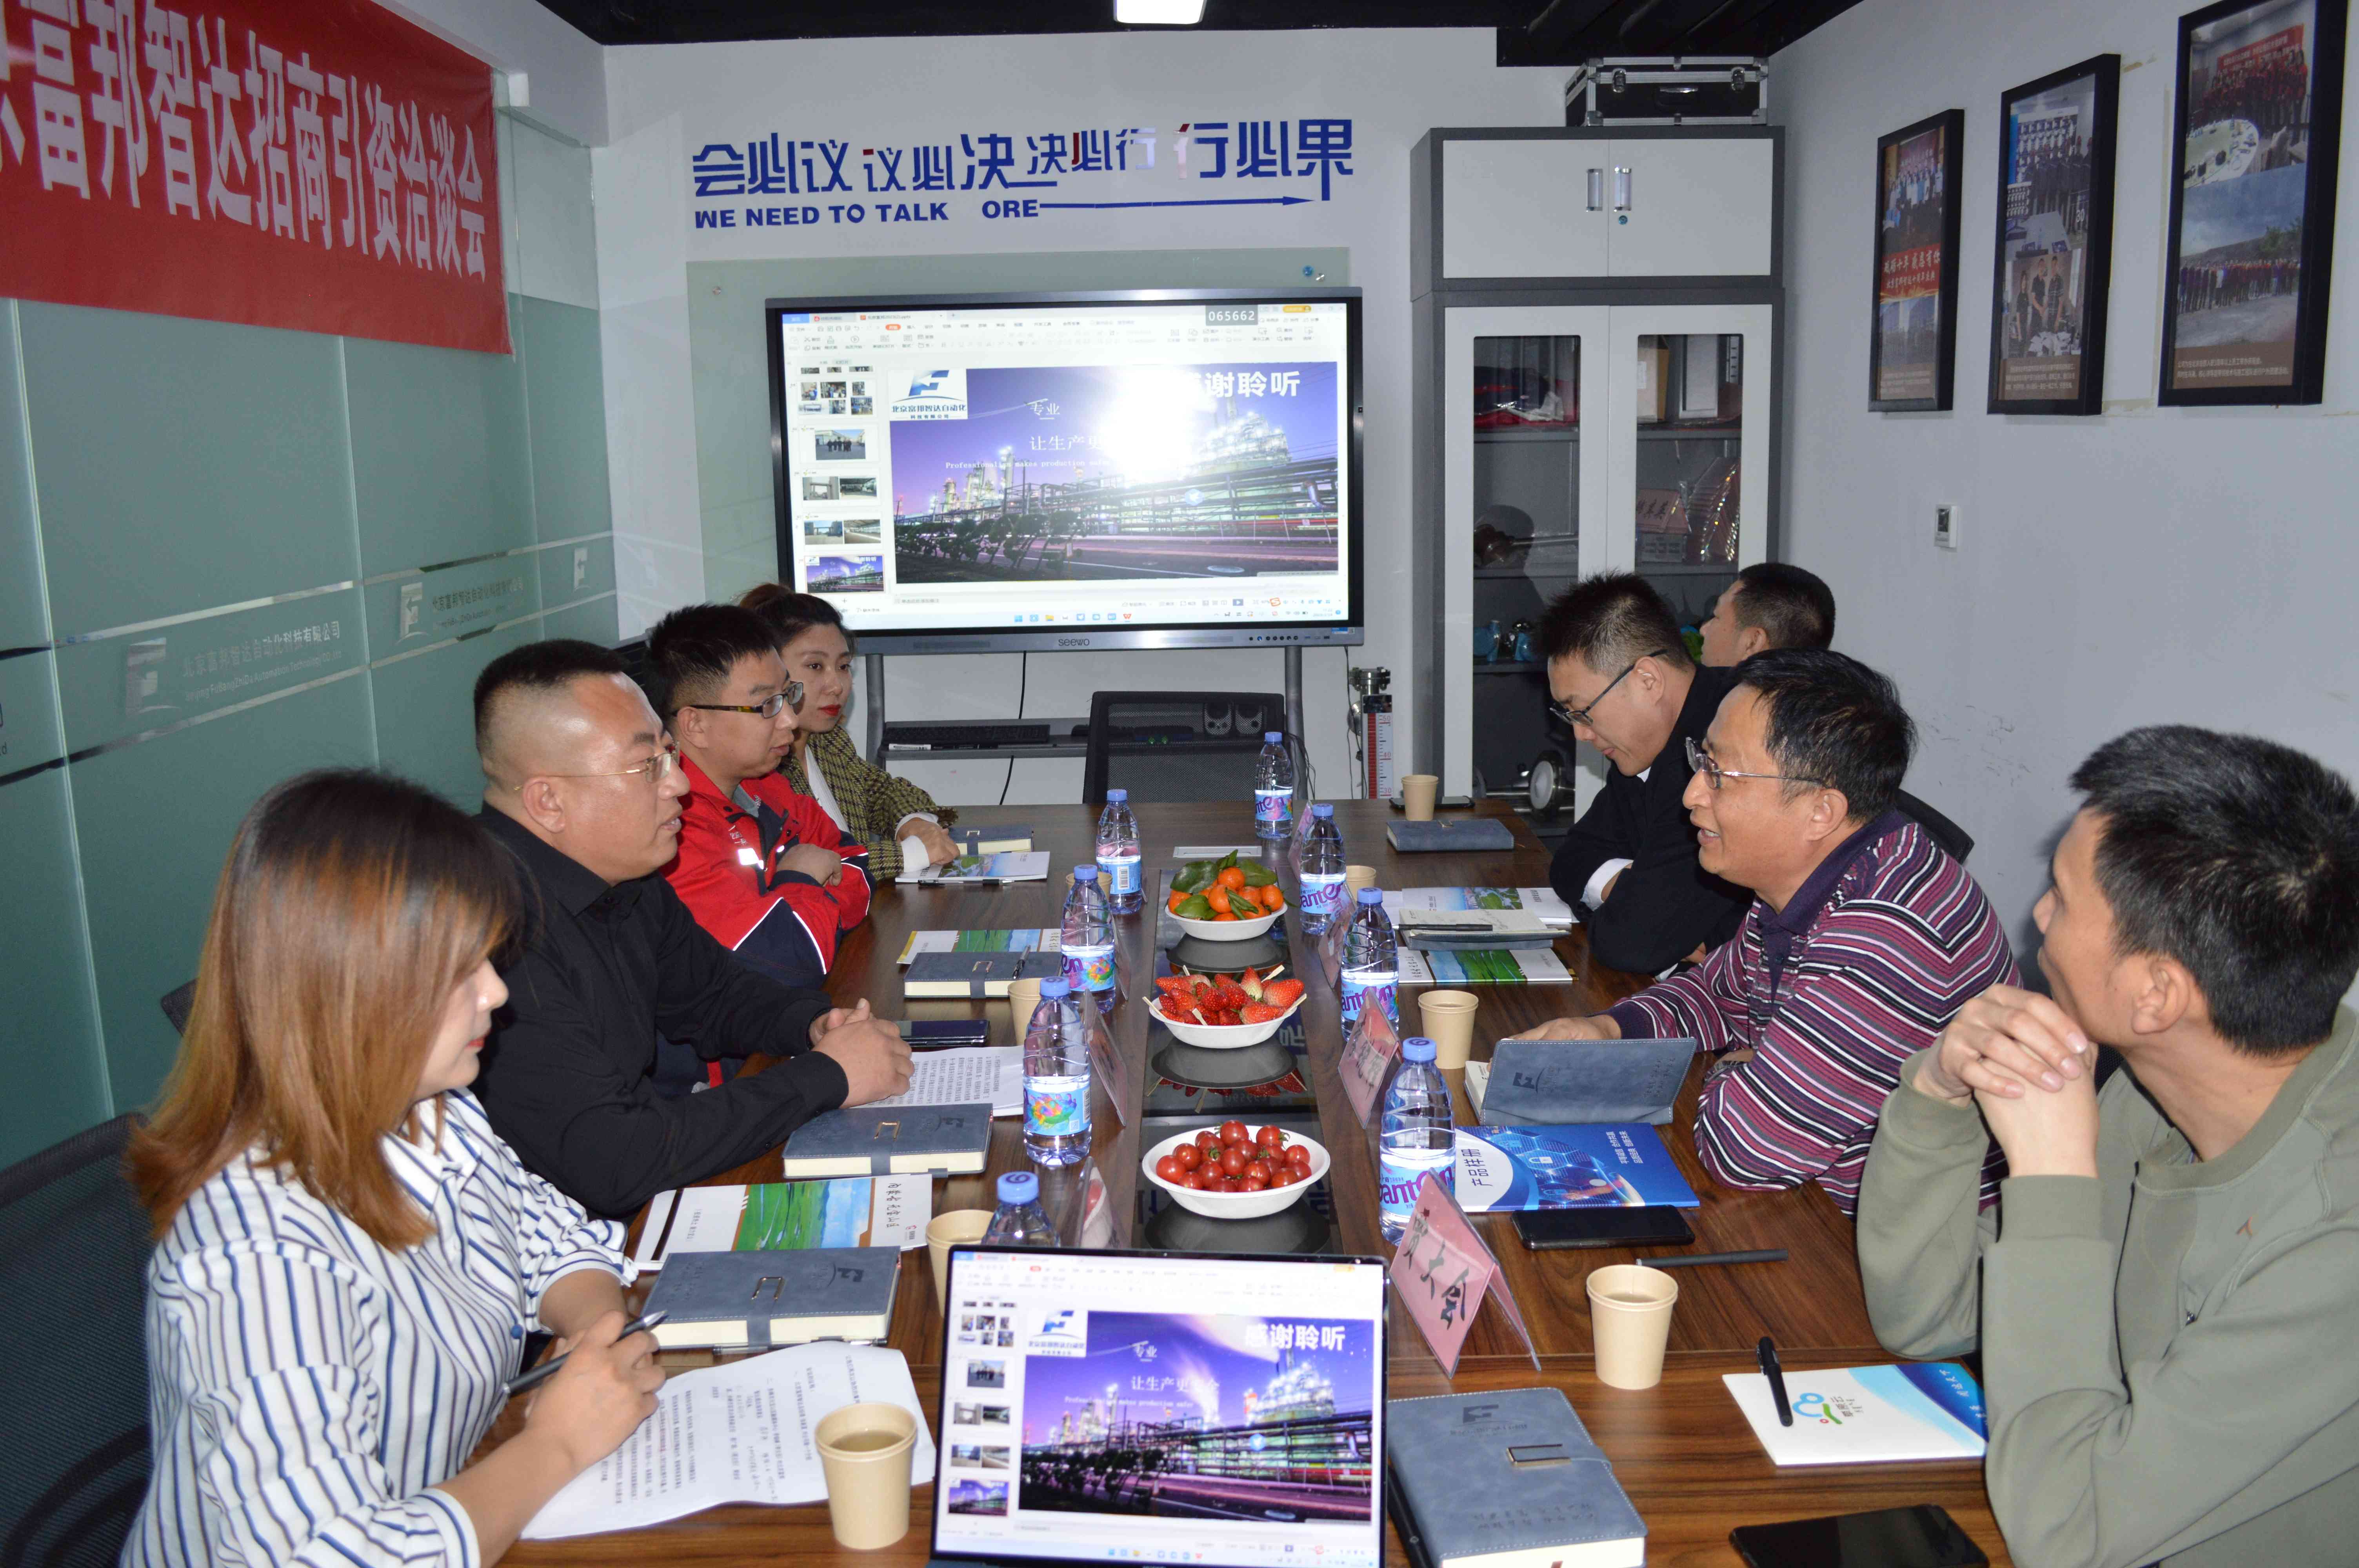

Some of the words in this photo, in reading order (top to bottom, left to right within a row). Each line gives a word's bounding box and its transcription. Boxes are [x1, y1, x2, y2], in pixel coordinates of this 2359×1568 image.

[0, 0, 485, 282] 富邦智达招商引资洽谈会
[695, 209, 736, 228] WE
[746, 206, 820, 226] NEED
[828, 204, 865, 223] TO
[875, 202, 949, 222] TALK
[982, 199, 1038, 219] ORE
[1208, 310, 1256, 321] 065662
[1030, 399, 1060, 416] 专业
[1058, 638, 1090, 647] seewo
[1462, 1148, 1494, 1187] 产品样册
[1244, 1323, 1346, 1351] 感谢聆听
